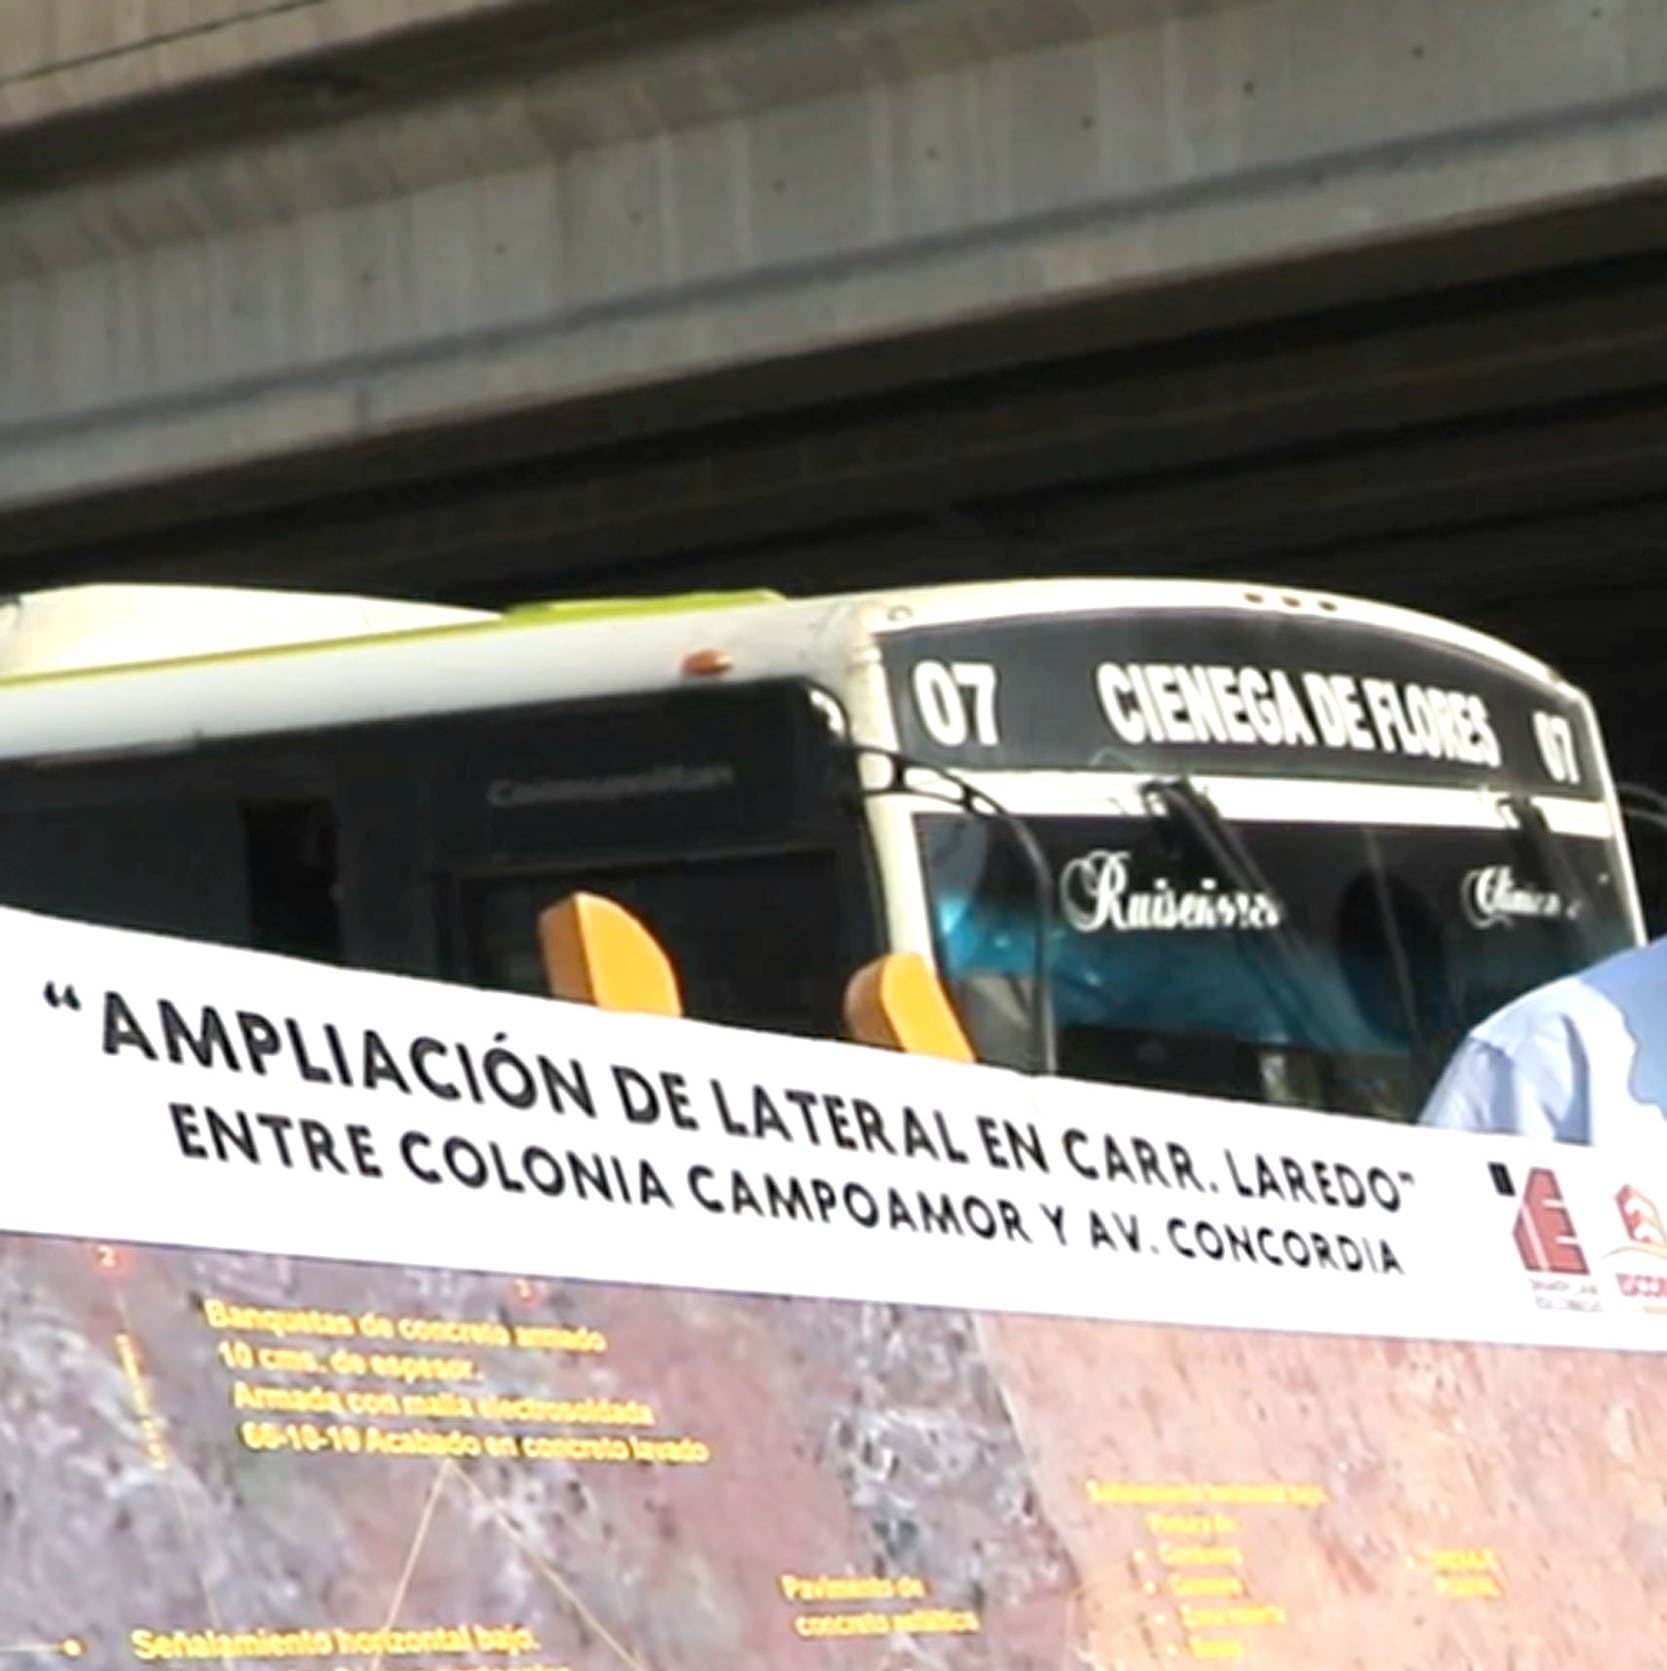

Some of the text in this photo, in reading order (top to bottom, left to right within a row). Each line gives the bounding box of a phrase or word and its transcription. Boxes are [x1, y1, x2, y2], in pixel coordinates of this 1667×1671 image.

[911, 661, 1582, 784] 07 CIENEGA DE FLORES 07
[169, 1102, 1405, 1276] ENTRE COLONIA CAMPOAMOR Y AV. CONCORDIA
[610, 1064, 698, 1130] DE
[711, 1078, 967, 1167] LATERAL
[986, 1113, 1050, 1177] EN
[1063, 1130, 1219, 1194] CARR.
[219, 1341, 254, 1370] 10
[330, 1349, 366, 1376] de
[358, 1312, 394, 1340] de
[398, 1318, 512, 1346] concreto
